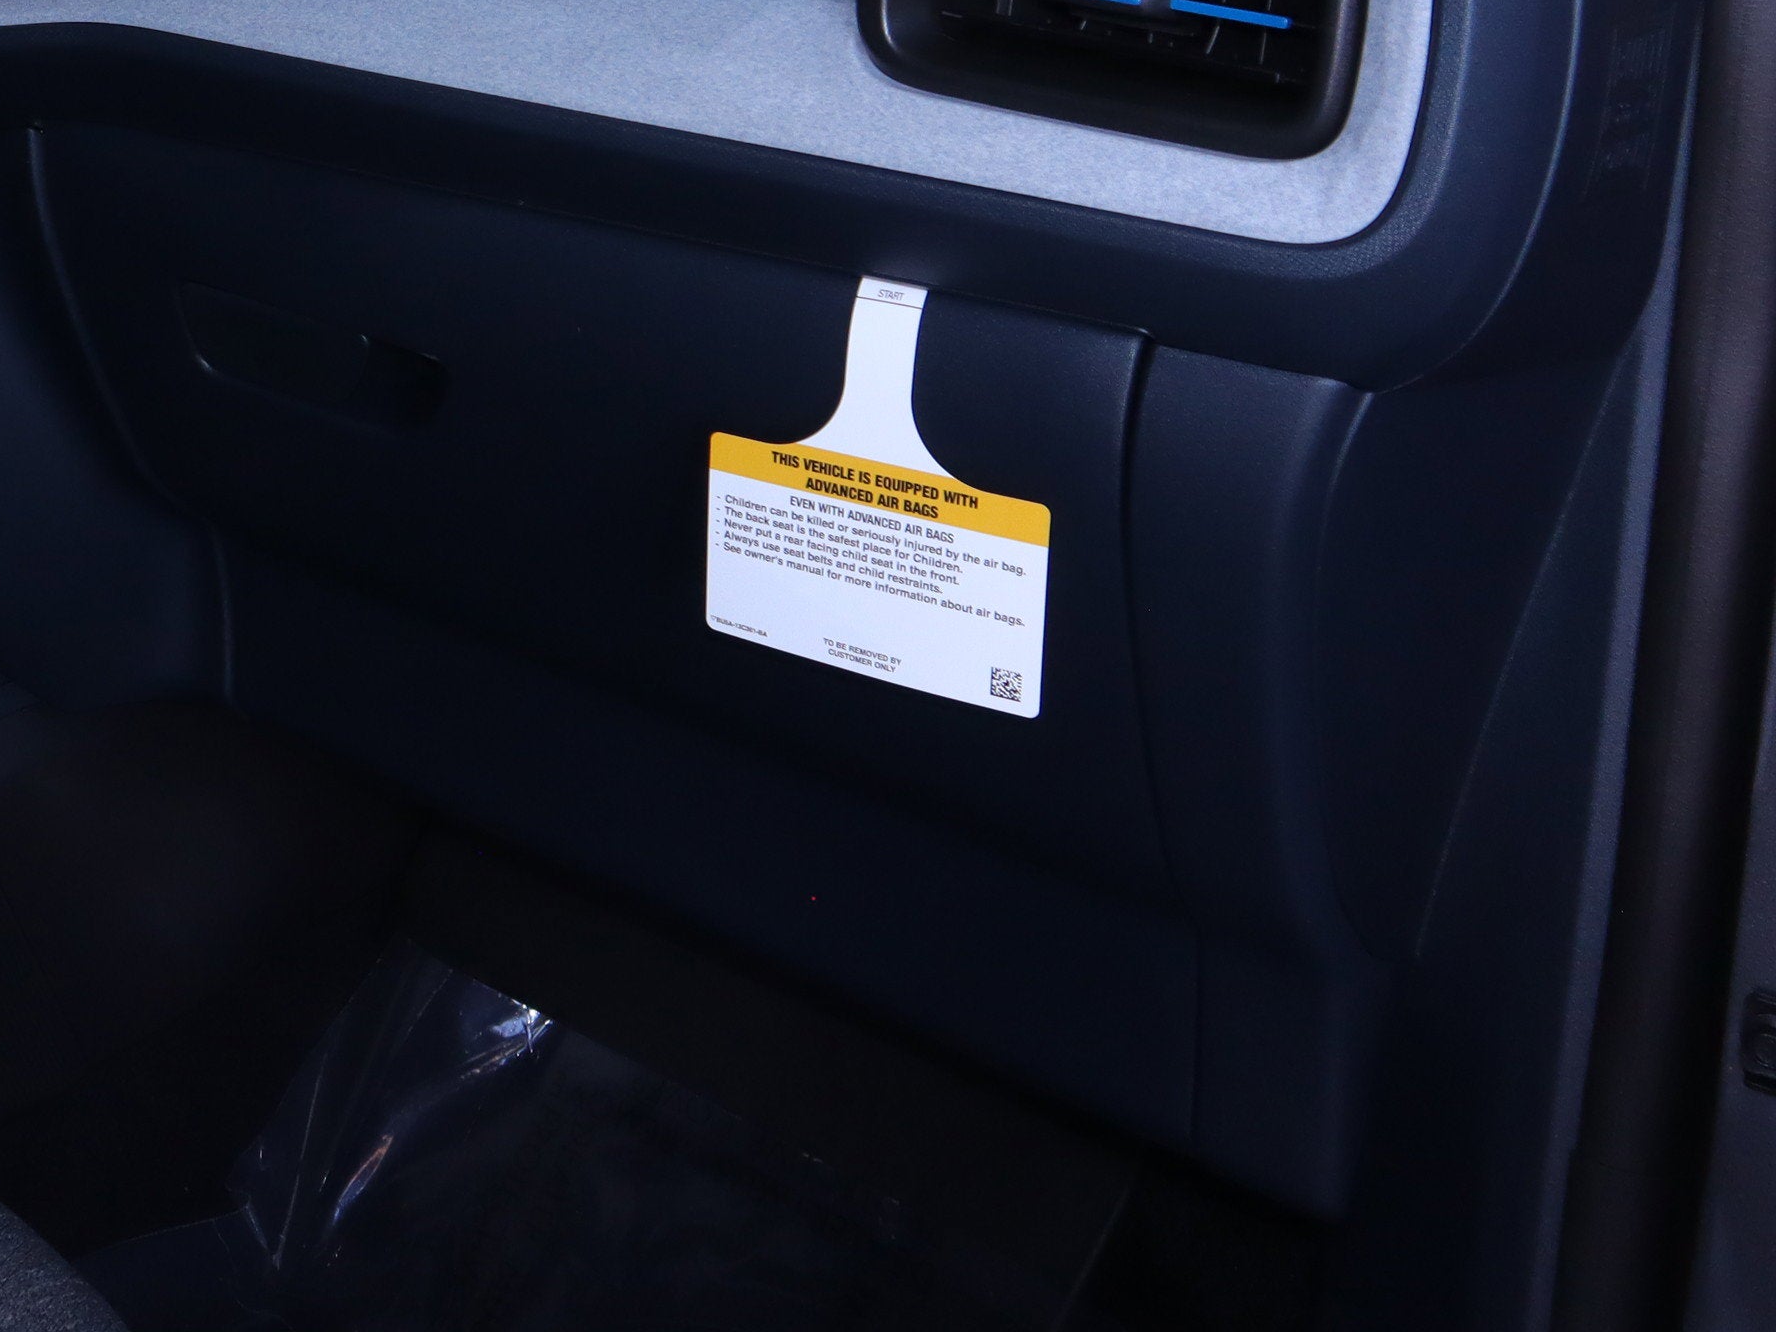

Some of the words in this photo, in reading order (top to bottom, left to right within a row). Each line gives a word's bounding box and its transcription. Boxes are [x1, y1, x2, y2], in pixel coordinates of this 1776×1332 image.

[878, 289, 905, 301] START
[772, 451, 800, 468] THIS
[803, 458, 855, 481] VEHICLE
[859, 471, 872, 484] IS
[875, 475, 939, 500] EQUIPPED
[943, 490, 979, 509] WITH
[806, 477, 873, 503] ADVANCED
[877, 494, 899, 510] AIR
[904, 500, 939, 518] BAGS
[725, 494, 767, 513] Children
[769, 508, 788, 518] can
[791, 509, 804, 522] be
[807, 513, 834, 529] killed
[837, 524, 849, 533] or
[852, 528, 901, 547] seriously
[904, 538, 942, 555] injured
[946, 548, 960, 561] by
[963, 552, 980, 565] the
[984, 559, 999, 569] air
[1002, 561, 1026, 577] bag.
[725, 506, 743, 518] The
[746, 511, 770, 525] back
[772, 520, 794, 532] seat
[797, 524, 805, 535] is
[809, 527, 825, 539] the
[828, 533, 860, 548] safest
[863, 542, 891, 557] place
[894, 549, 909, 560] for
[913, 553, 963, 573] Children.
[790, 496, 815, 511] EVEN
[818, 502, 844, 517] WITH
[848, 510, 901, 531] ADVANCED
[904, 523, 922, 536] AIR
[926, 527, 954, 543] BAGS
[724, 518, 753, 532] Never
[755, 527, 772, 539] put
[775, 532, 781, 541] a
[784, 534, 805, 546] rear
[807, 539, 839, 557] facing
[842, 548, 868, 562] child
[871, 556, 893, 569] seat
[897, 562, 907, 572] in
[910, 565, 927, 577] the
[930, 569, 959, 585] front.
[724, 530, 759, 547] Always
[762, 542, 780, 553] use
[783, 547, 805, 559] seat
[808, 552, 833, 567] belts
[836, 559, 855, 572] and
[858, 566, 885, 579] child
[888, 573, 943, 594] restraints.
[724, 541, 742, 554] See
[744, 549, 783, 566] owner's
[786, 560, 824, 576] manual
[827, 568, 841, 580] for
[845, 575, 872, 589] more
[875, 581, 938, 606] information
[941, 599, 973, 615] about
[976, 607, 991, 618] air
[994, 610, 1025, 627] bags.
[823, 637, 835, 647] TO
[836, 641, 847, 651] BE
[849, 645, 888, 662] REMOVED
[890, 656, 902, 666] BY
[828, 648, 873, 667] CUSTOMER
[874, 661, 897, 673] ONLY
